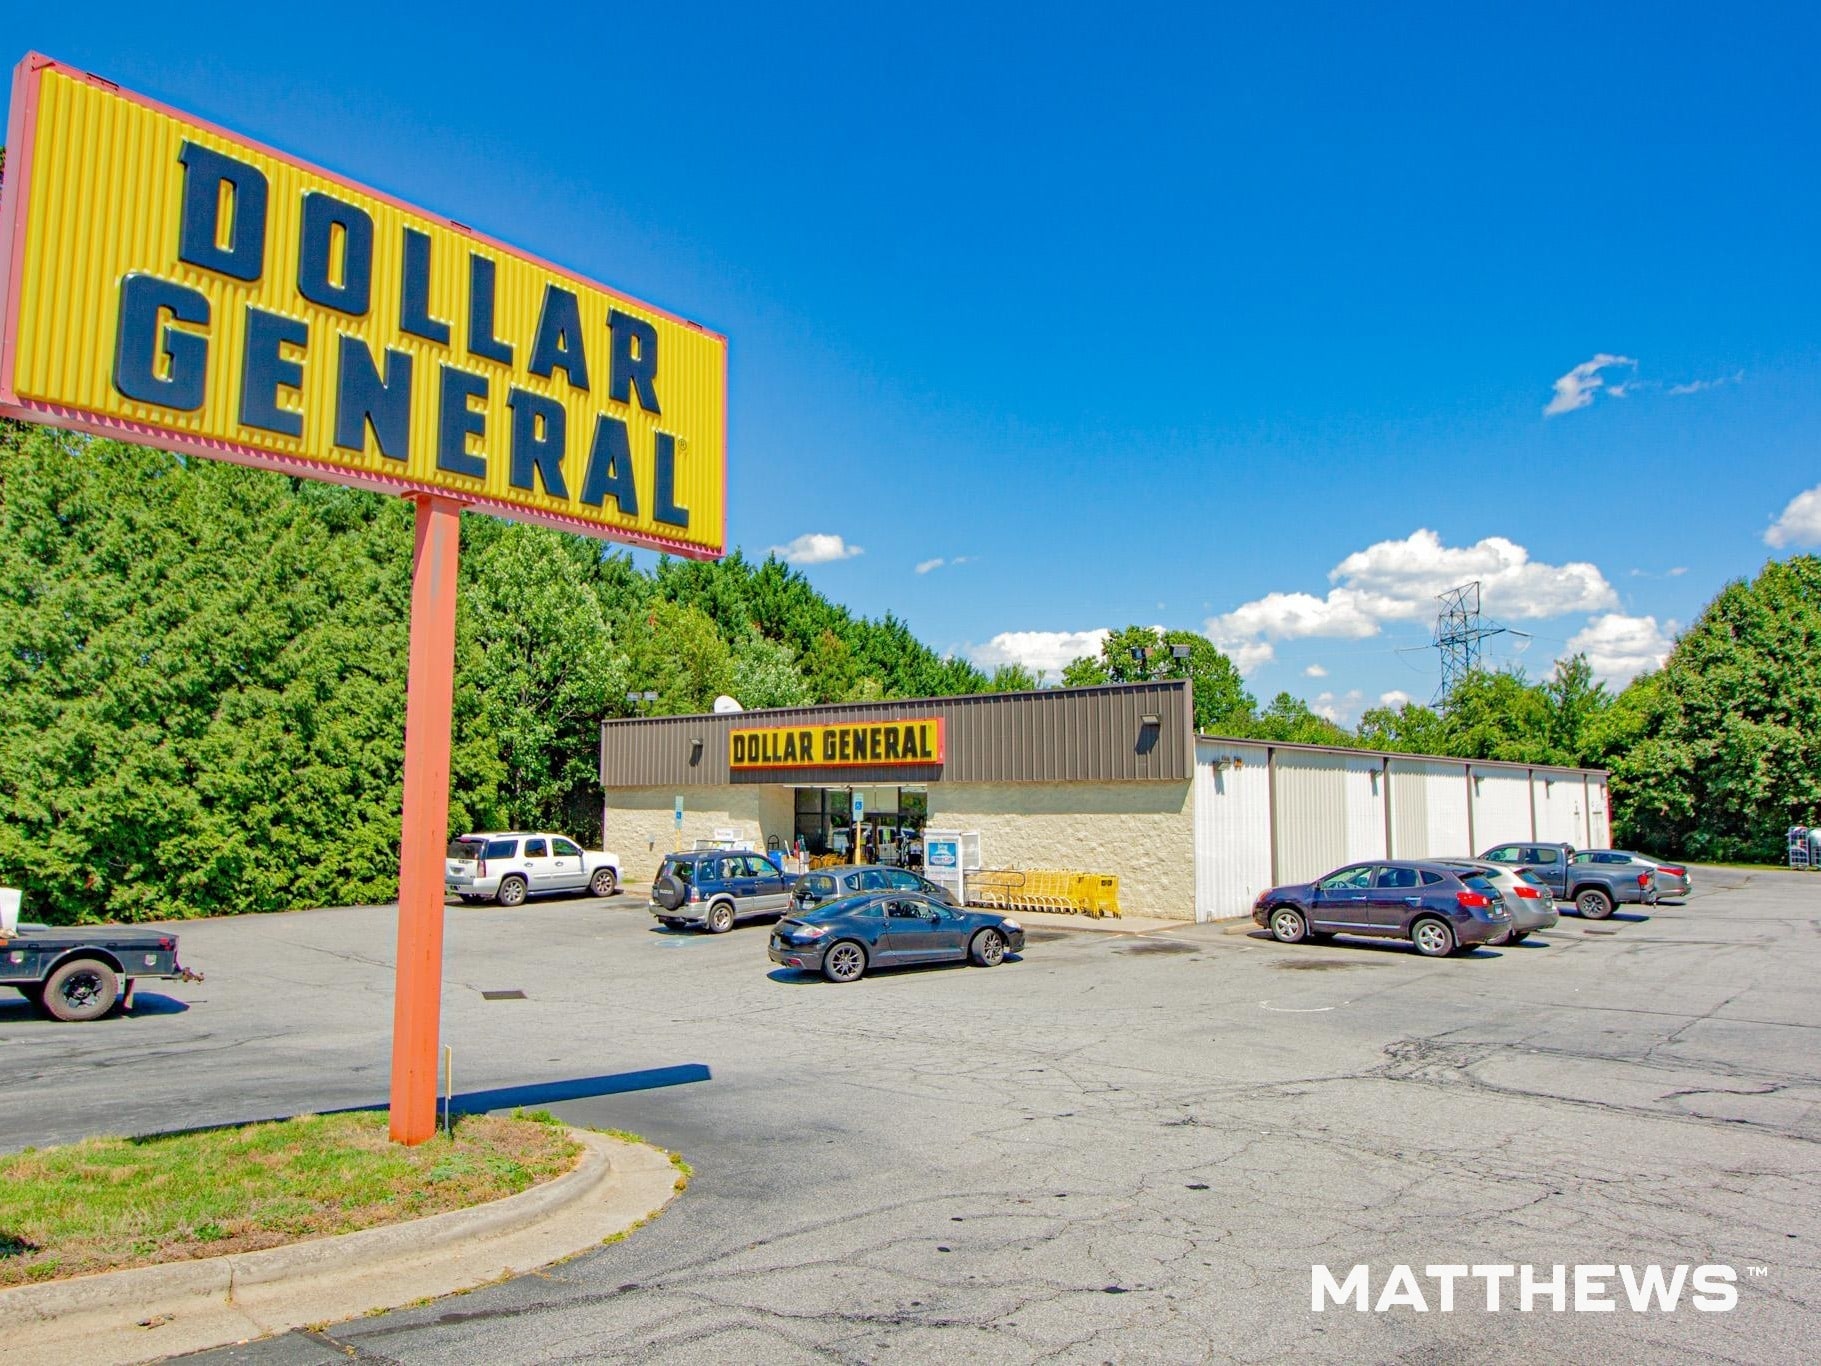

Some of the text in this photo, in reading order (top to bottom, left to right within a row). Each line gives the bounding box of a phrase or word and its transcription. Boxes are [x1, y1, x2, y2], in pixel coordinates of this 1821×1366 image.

[110, 275, 690, 529] GENERAL
[177, 140, 661, 416] DOLLAR
[733, 724, 932, 763] DOLLAR GENERAL
